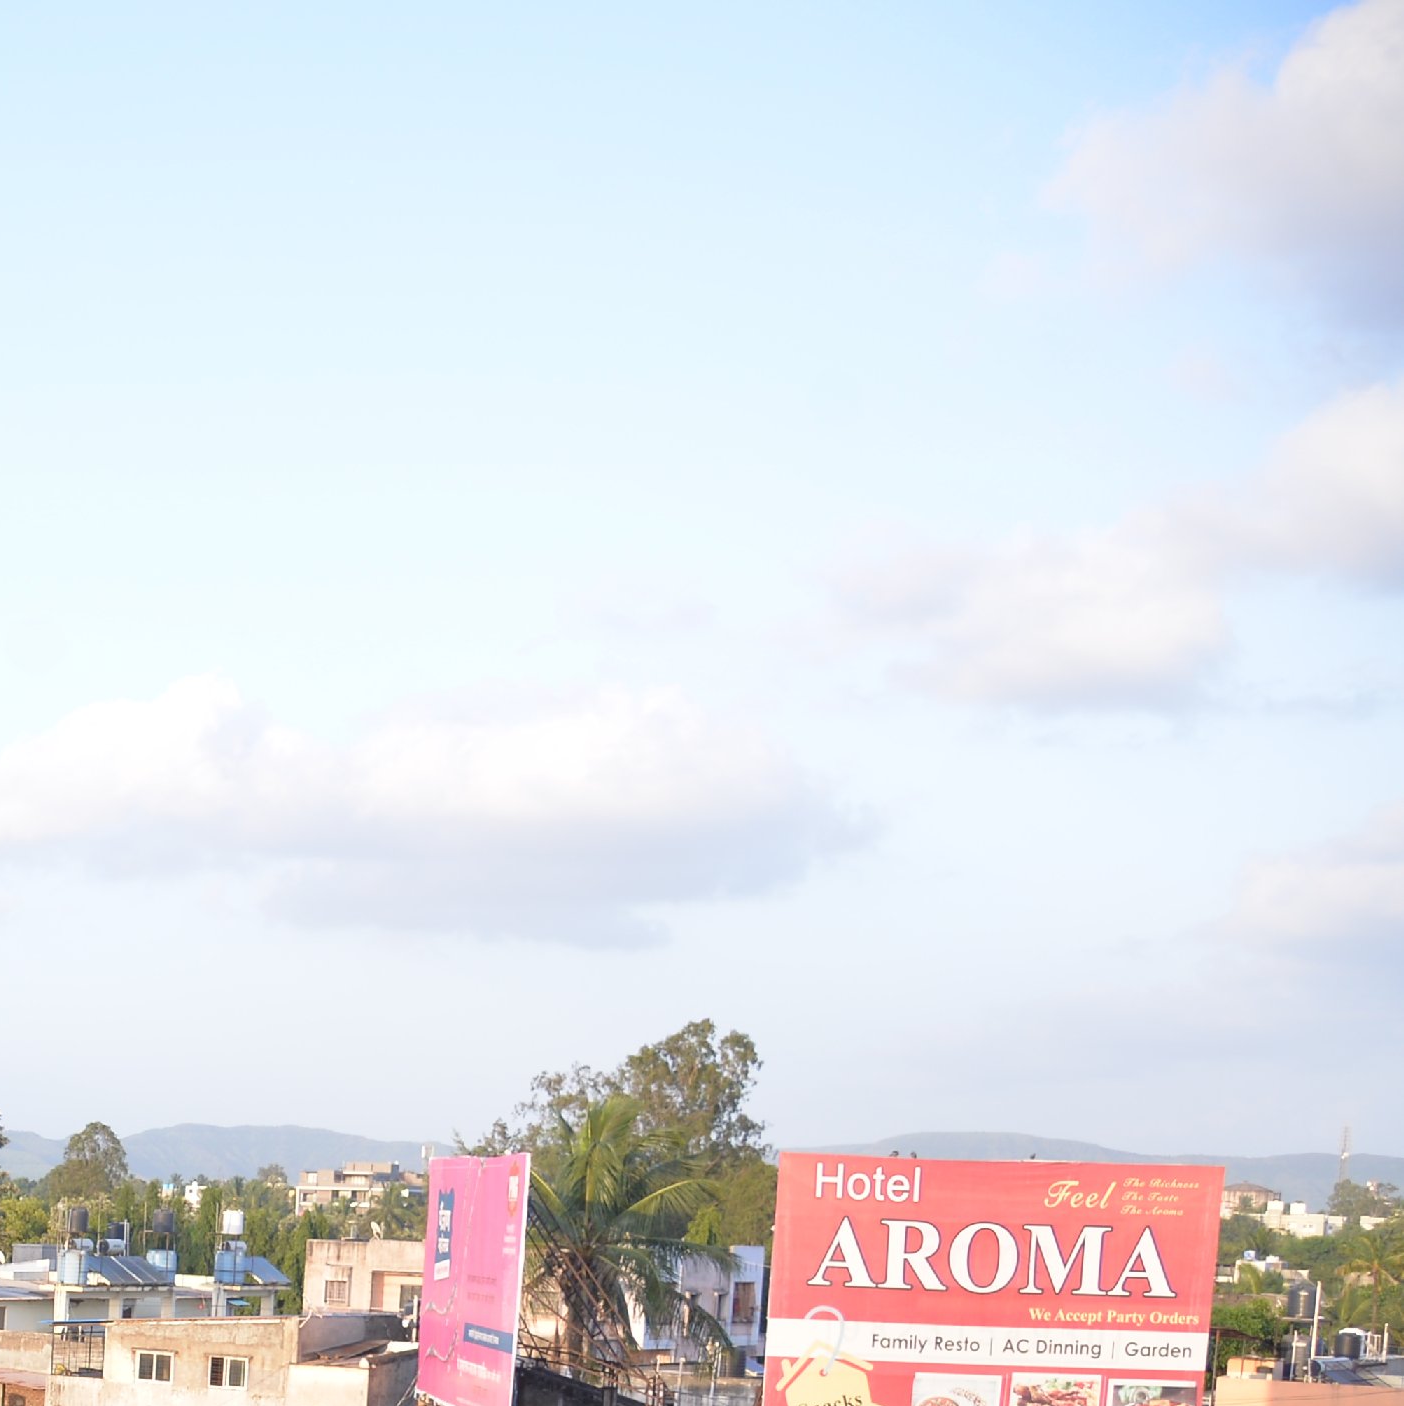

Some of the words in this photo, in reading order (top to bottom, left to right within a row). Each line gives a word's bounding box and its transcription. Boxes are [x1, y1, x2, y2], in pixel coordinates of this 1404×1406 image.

[815, 1162, 921, 1202] Hotel
[1044, 1180, 1117, 1209] Feel
[807, 1216, 1177, 1298] AROMA
[1029, 1308, 1051, 1322] We
[1054, 1308, 1102, 1326] Accept
[1106, 1310, 1145, 1327] Party
[1149, 1313, 1200, 1325] Orders
[871, 1333, 927, 1352] Family
[934, 1336, 980, 1352] Resto
[1002, 1339, 1029, 1354] AC
[1036, 1339, 1102, 1359] Dinning
[1124, 1342, 1193, 1359] Garden
